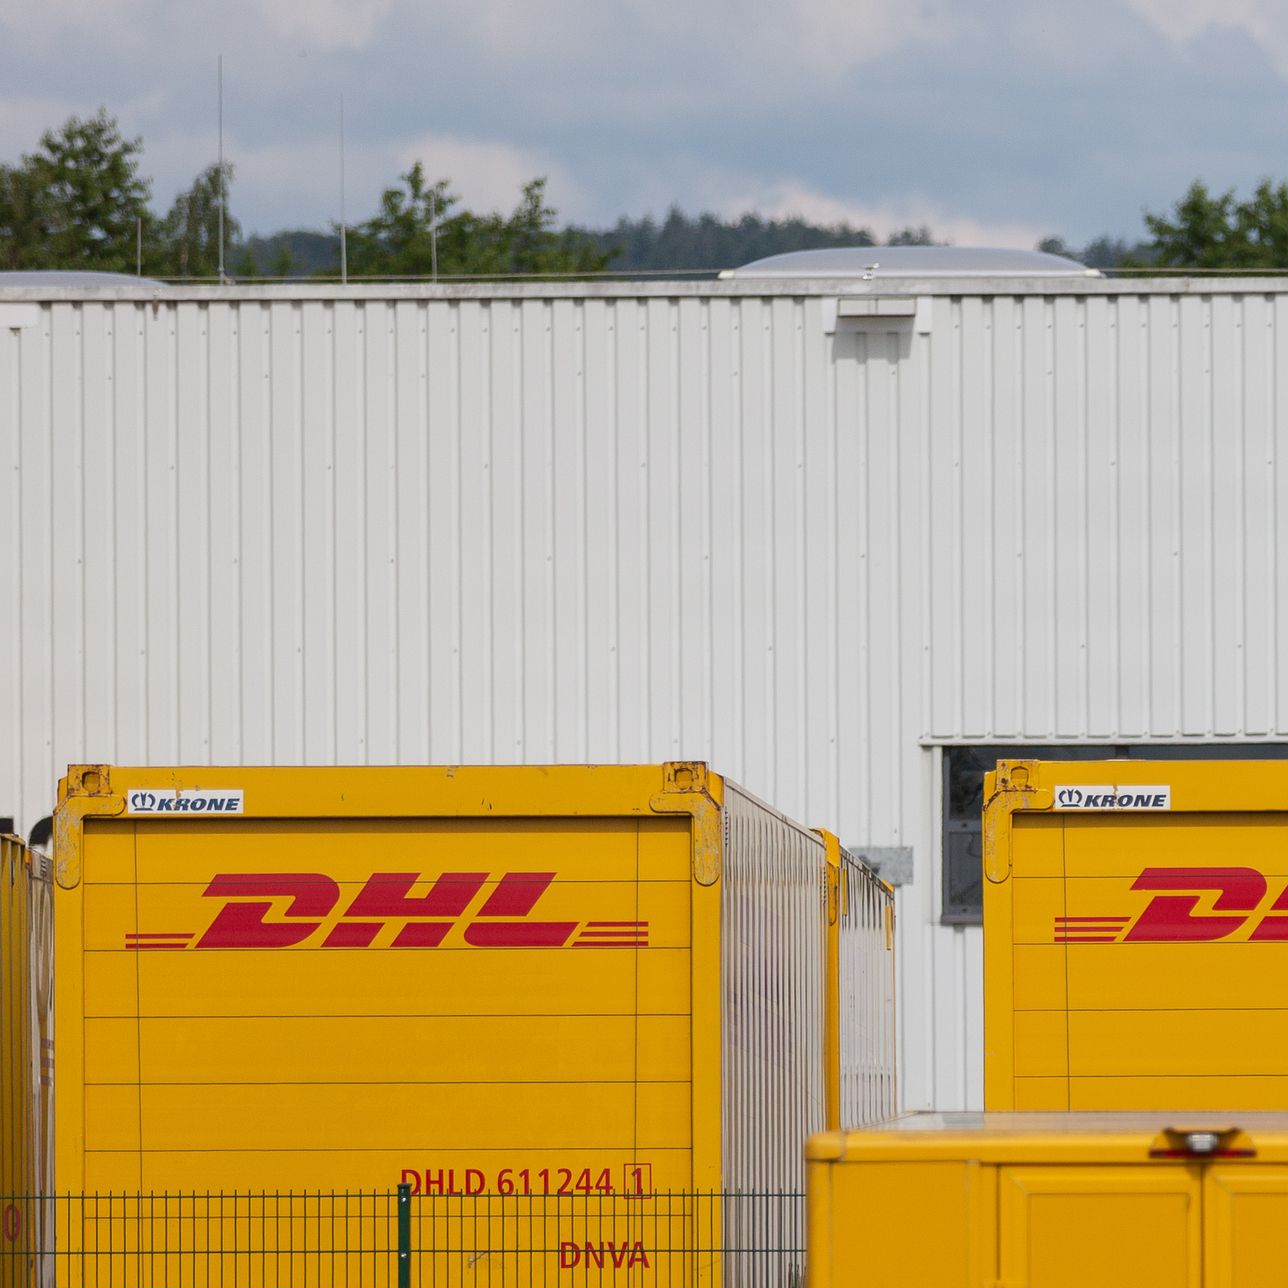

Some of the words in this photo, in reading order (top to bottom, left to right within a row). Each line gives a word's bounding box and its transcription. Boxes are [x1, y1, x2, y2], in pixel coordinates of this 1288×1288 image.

[157, 797, 240, 812] KRONE
[1084, 794, 1167, 808] KRONE
[195, 872, 580, 949] DHL
[401, 1168, 486, 1197] DHLD
[497, 1167, 614, 1197] 611244
[560, 1240, 650, 1269] DNVA
